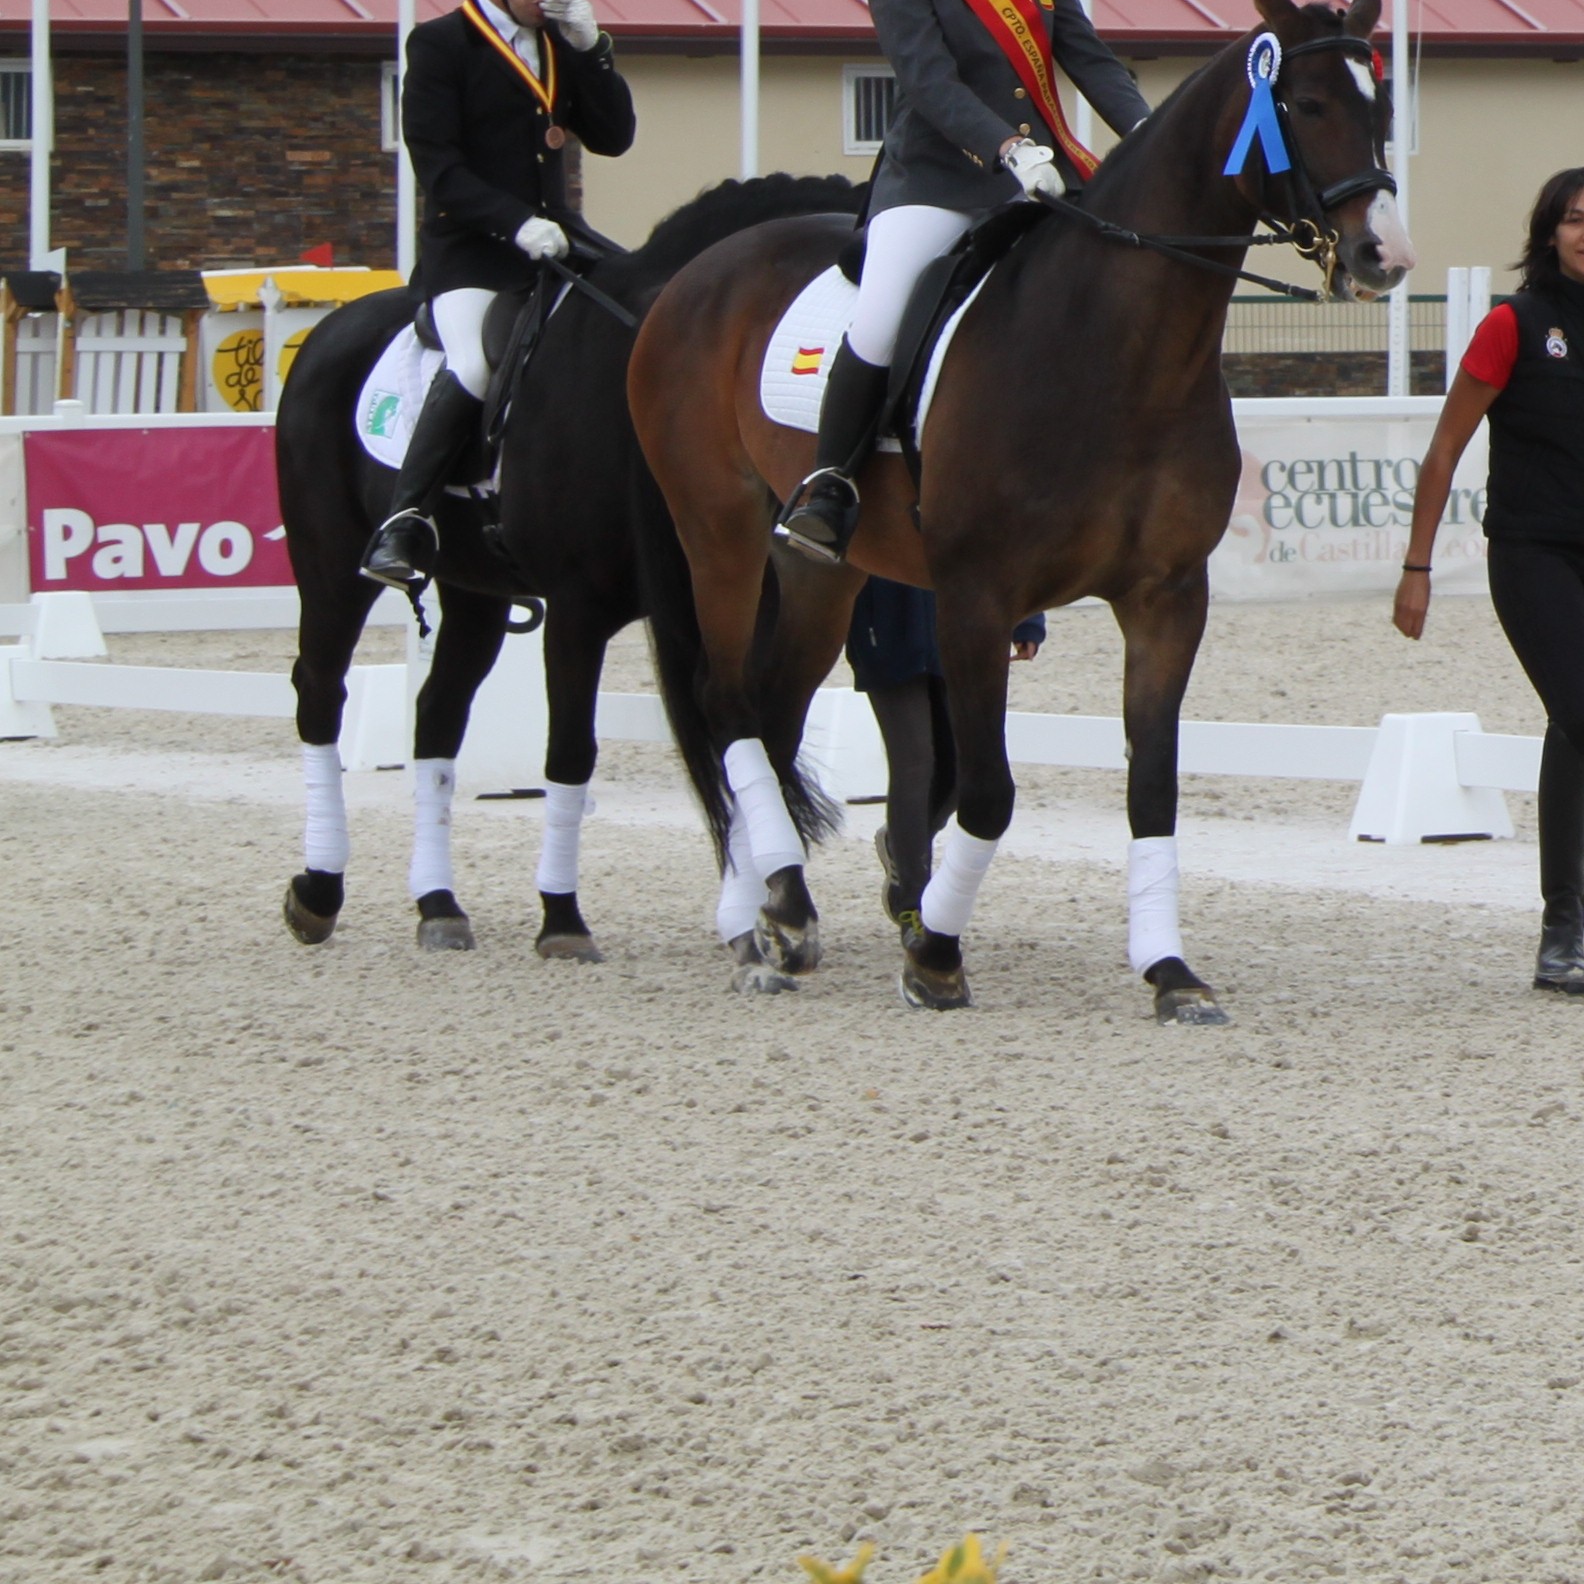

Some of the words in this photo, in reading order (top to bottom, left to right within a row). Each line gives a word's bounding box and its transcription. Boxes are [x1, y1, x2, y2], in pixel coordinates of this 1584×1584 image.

[1002, 7, 1026, 39] CPTO.
[1023, 39, 1046, 82] ESPAÑA
[1261, 451, 1422, 493] centro
[1263, 485, 1487, 530] ecuesre
[43, 507, 254, 580] Pavo
[1269, 540, 1297, 563] de
